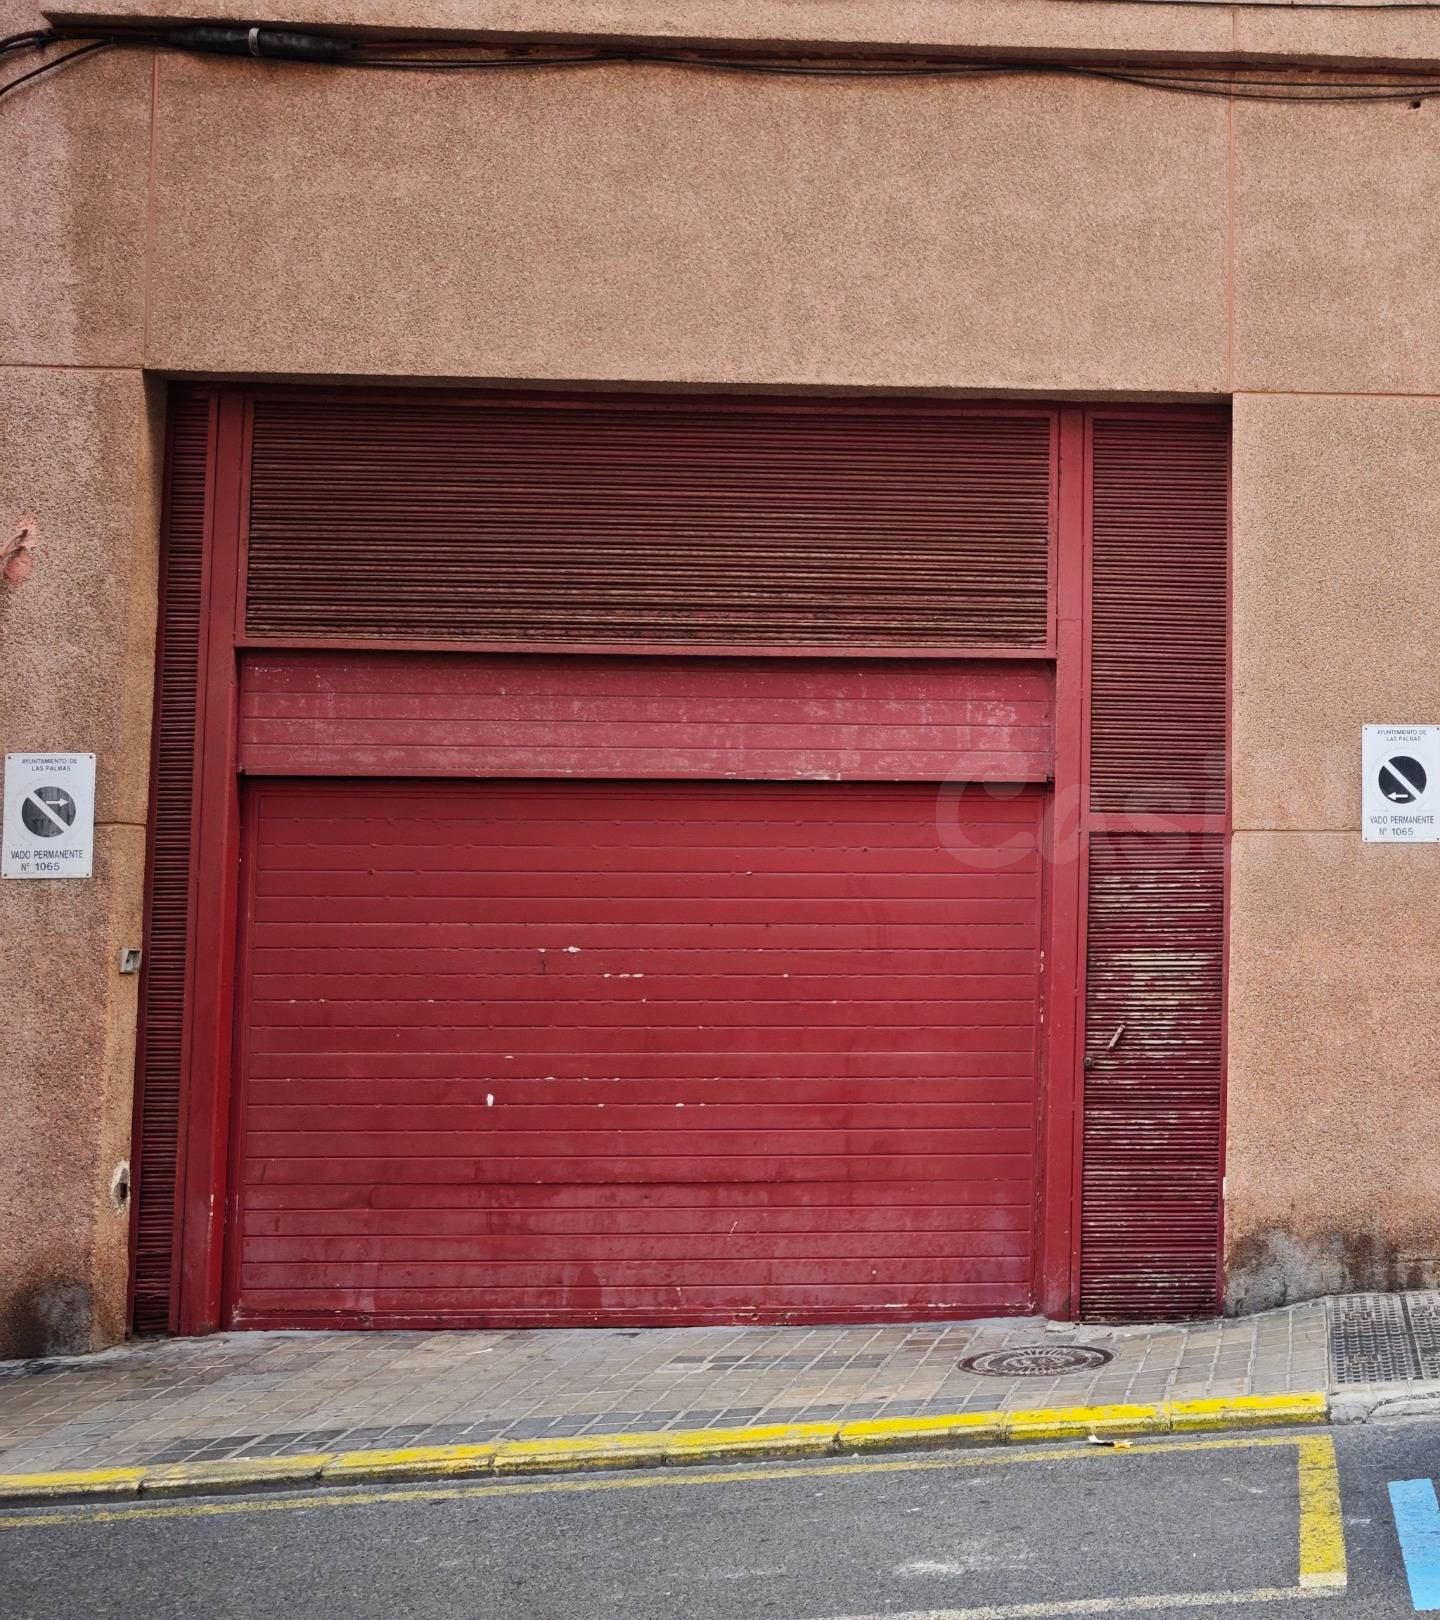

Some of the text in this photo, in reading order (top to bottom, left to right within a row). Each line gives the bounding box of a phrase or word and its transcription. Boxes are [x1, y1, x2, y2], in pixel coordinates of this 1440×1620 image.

[1370, 815, 1435, 824] VADO PERMANENTE
[1392, 827, 1414, 836] 1065
[11, 849, 84, 859] VADO PERMANENTE
[35, 862, 60, 871] 1065
